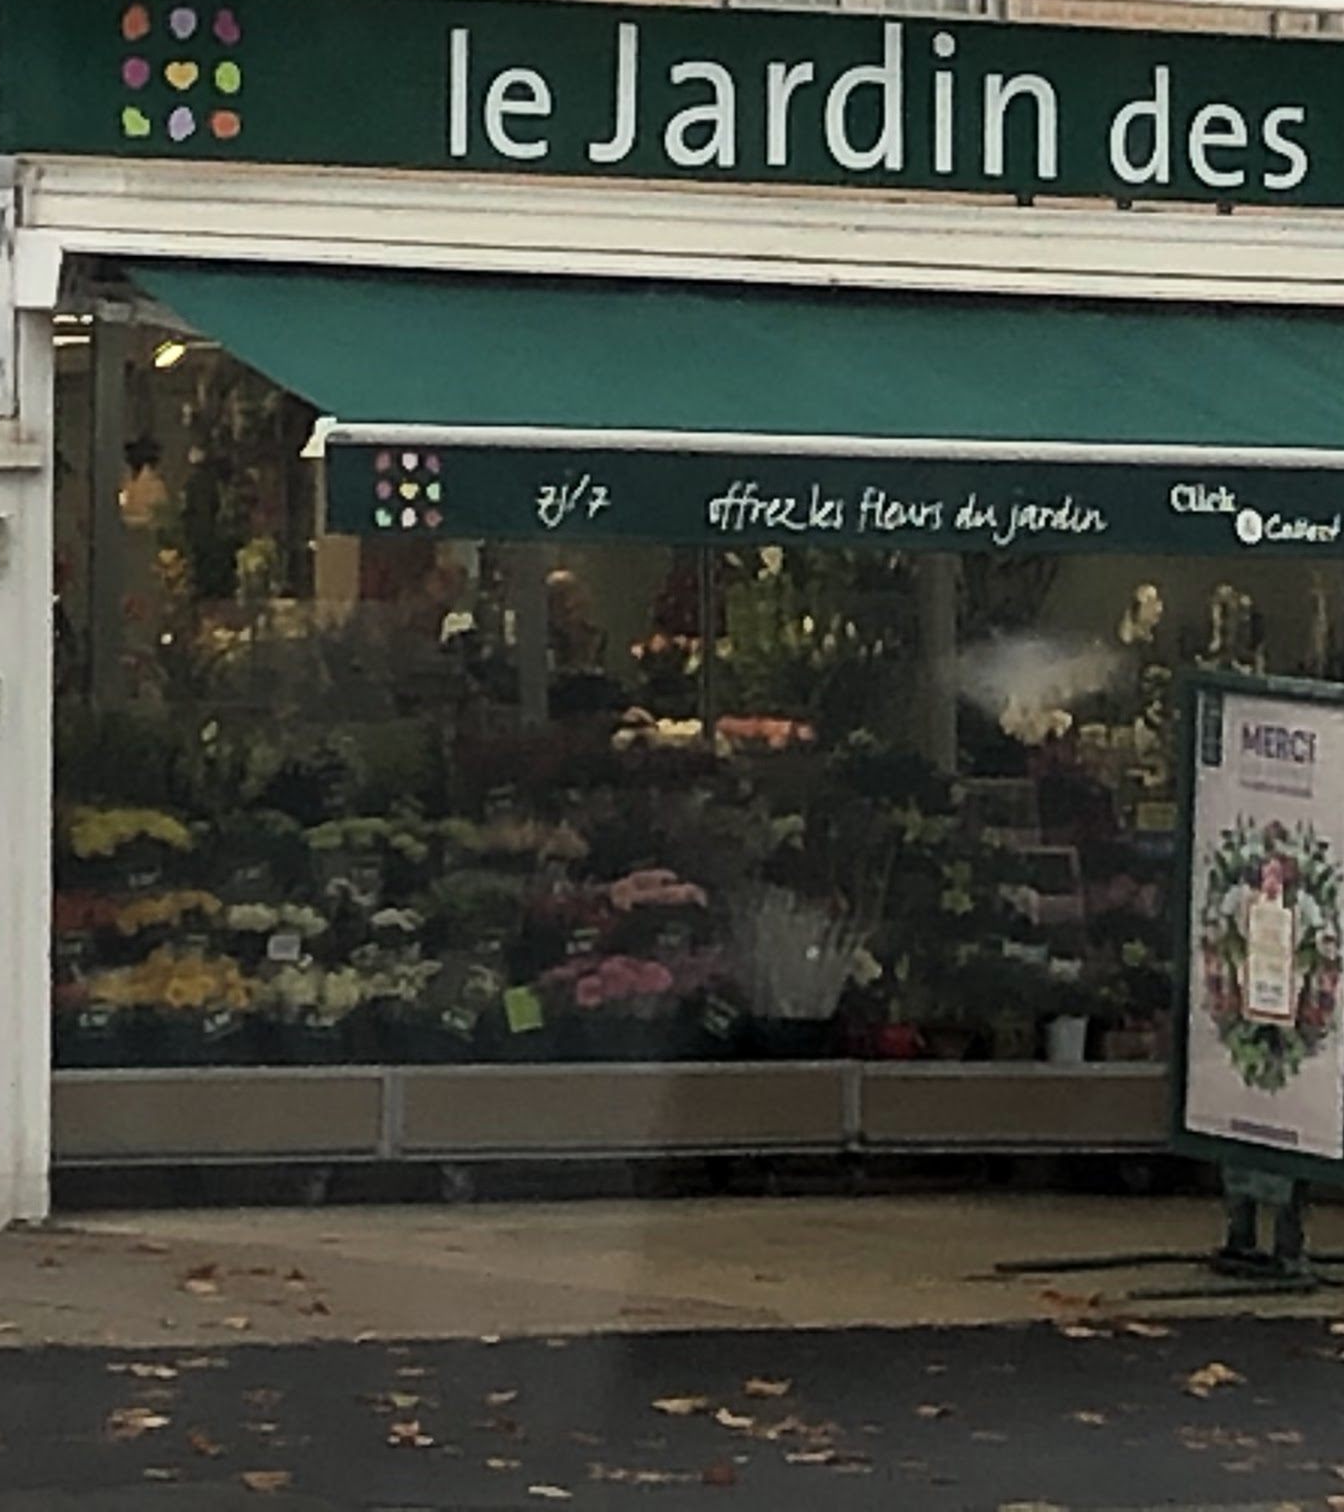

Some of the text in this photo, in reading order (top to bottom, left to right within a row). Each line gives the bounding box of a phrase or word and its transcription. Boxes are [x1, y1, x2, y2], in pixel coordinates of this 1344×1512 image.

[449, 28, 552, 159] le
[588, 22, 1058, 178] Jardin
[1108, 65, 1308, 190] des
[809, 482, 845, 531] les
[954, 491, 996, 531] du
[992, 494, 1109, 546] jardin
[1169, 482, 1237, 513] Click
[1241, 723, 1317, 765] MERCI
